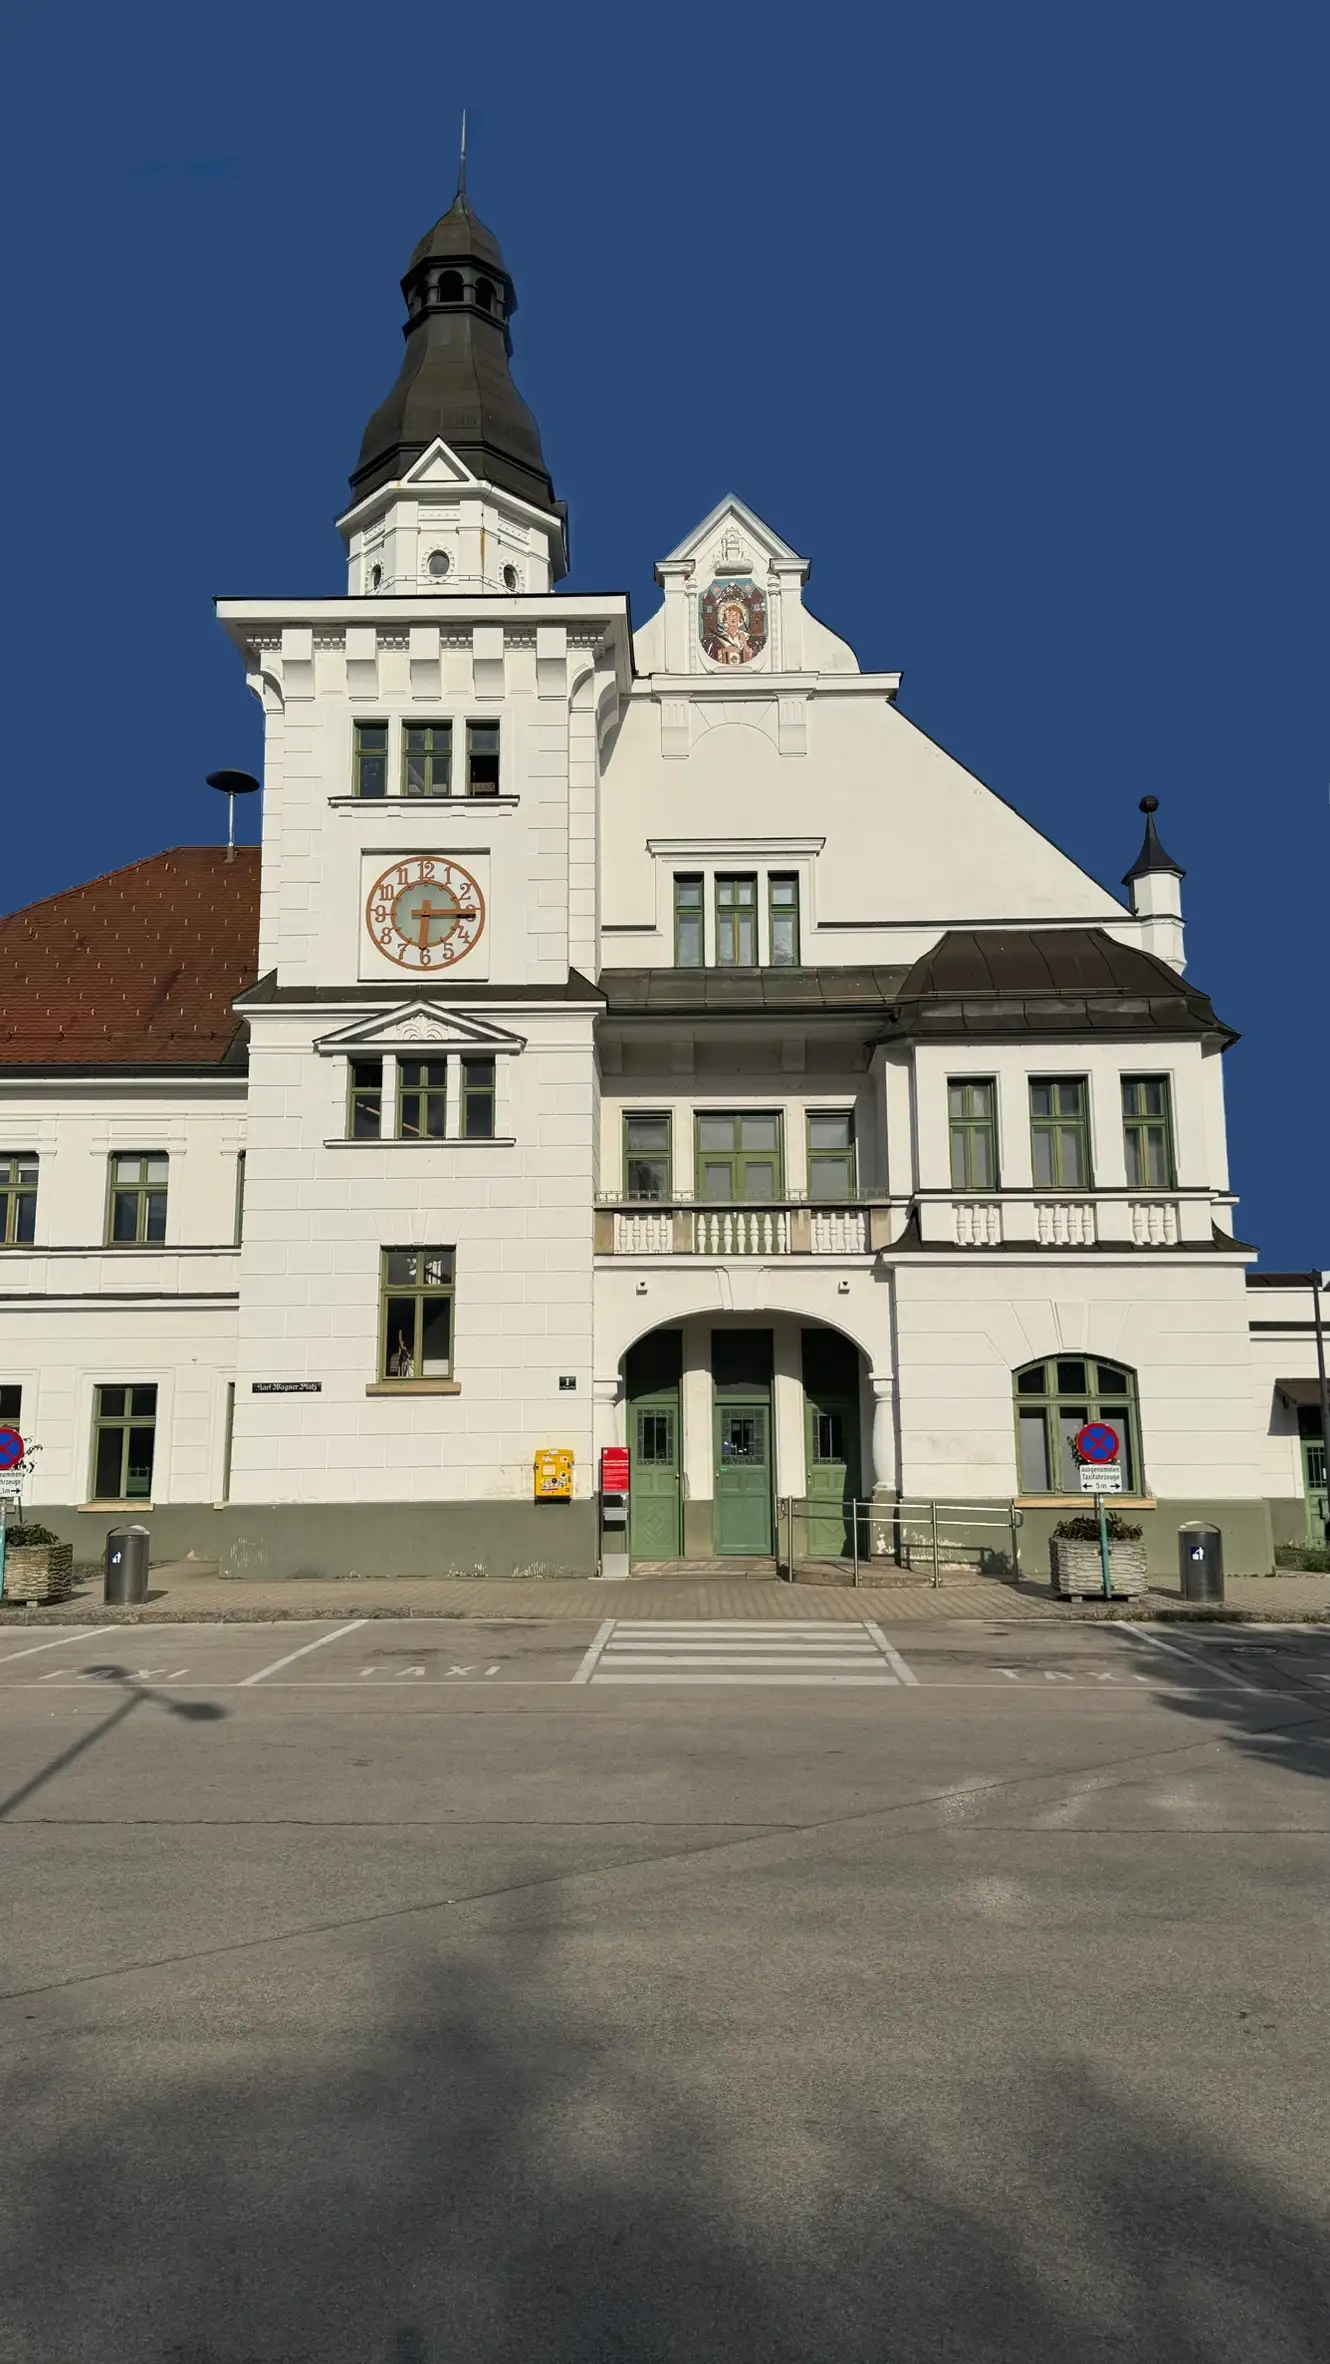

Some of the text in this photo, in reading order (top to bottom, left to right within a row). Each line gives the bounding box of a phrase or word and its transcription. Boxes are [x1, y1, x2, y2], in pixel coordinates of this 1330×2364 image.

[396, 867, 409, 885] 11
[417, 860, 435, 880] 12
[444, 865, 453, 885] 1
[378, 884, 394, 901] 10
[459, 882, 471, 900] 2
[375, 904, 386, 923] 9
[380, 927, 392, 944] 8
[457, 925, 471, 944] 4
[397, 943, 408, 961] 7
[420, 947, 431, 966] 6
[442, 942, 455, 960] 5
[256, 1382, 317, 1392] Karl Wagner Platz
[38, 1667, 191, 1680] TAXI
[360, 1666, 501, 1677] TAXI
[990, 1668, 1150, 1682] TAXI
